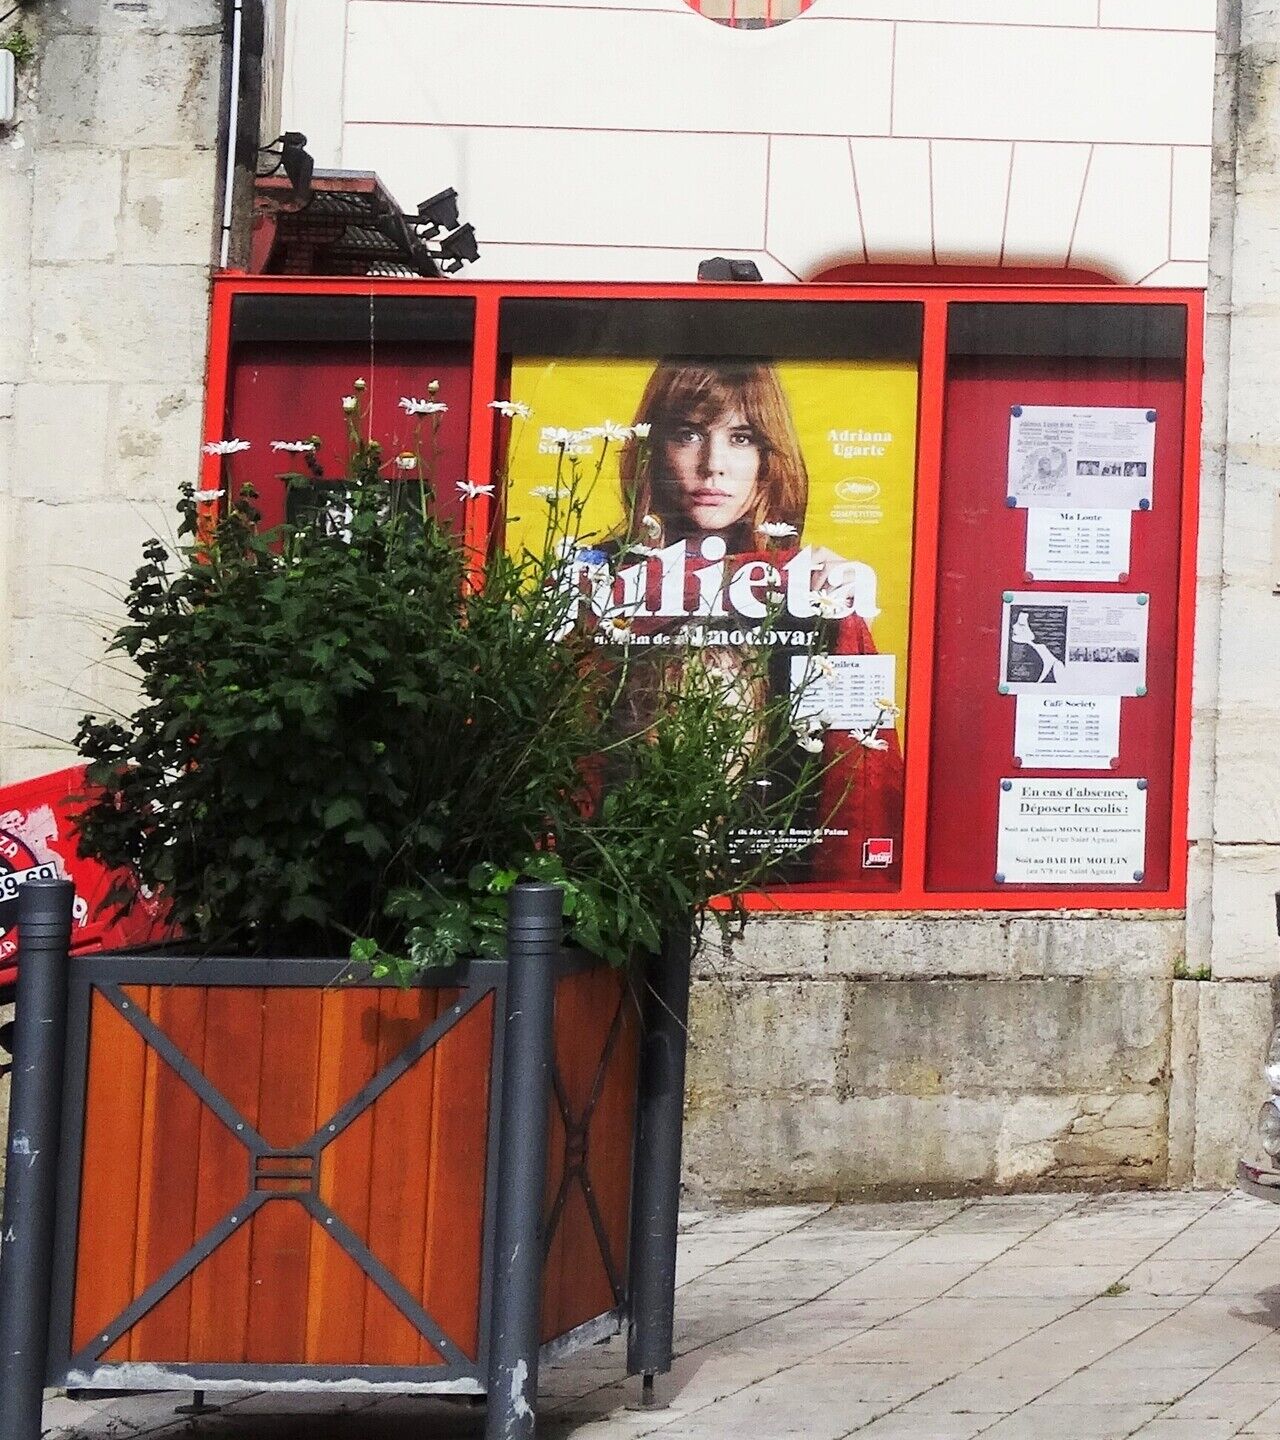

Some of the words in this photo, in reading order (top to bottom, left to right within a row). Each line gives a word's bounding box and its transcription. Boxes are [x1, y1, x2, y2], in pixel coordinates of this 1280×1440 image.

[828, 428, 893, 442] Adriana
[833, 444, 886, 458] Ugarte
[1021, 786, 1040, 798] En
[1042, 789, 1062, 798] cas
[1065, 786, 1129, 799] d'absence,
[1019, 802, 1072, 816] Déposer
[1074, 803, 1091, 814] les
[1093, 803, 1122, 814] colis
